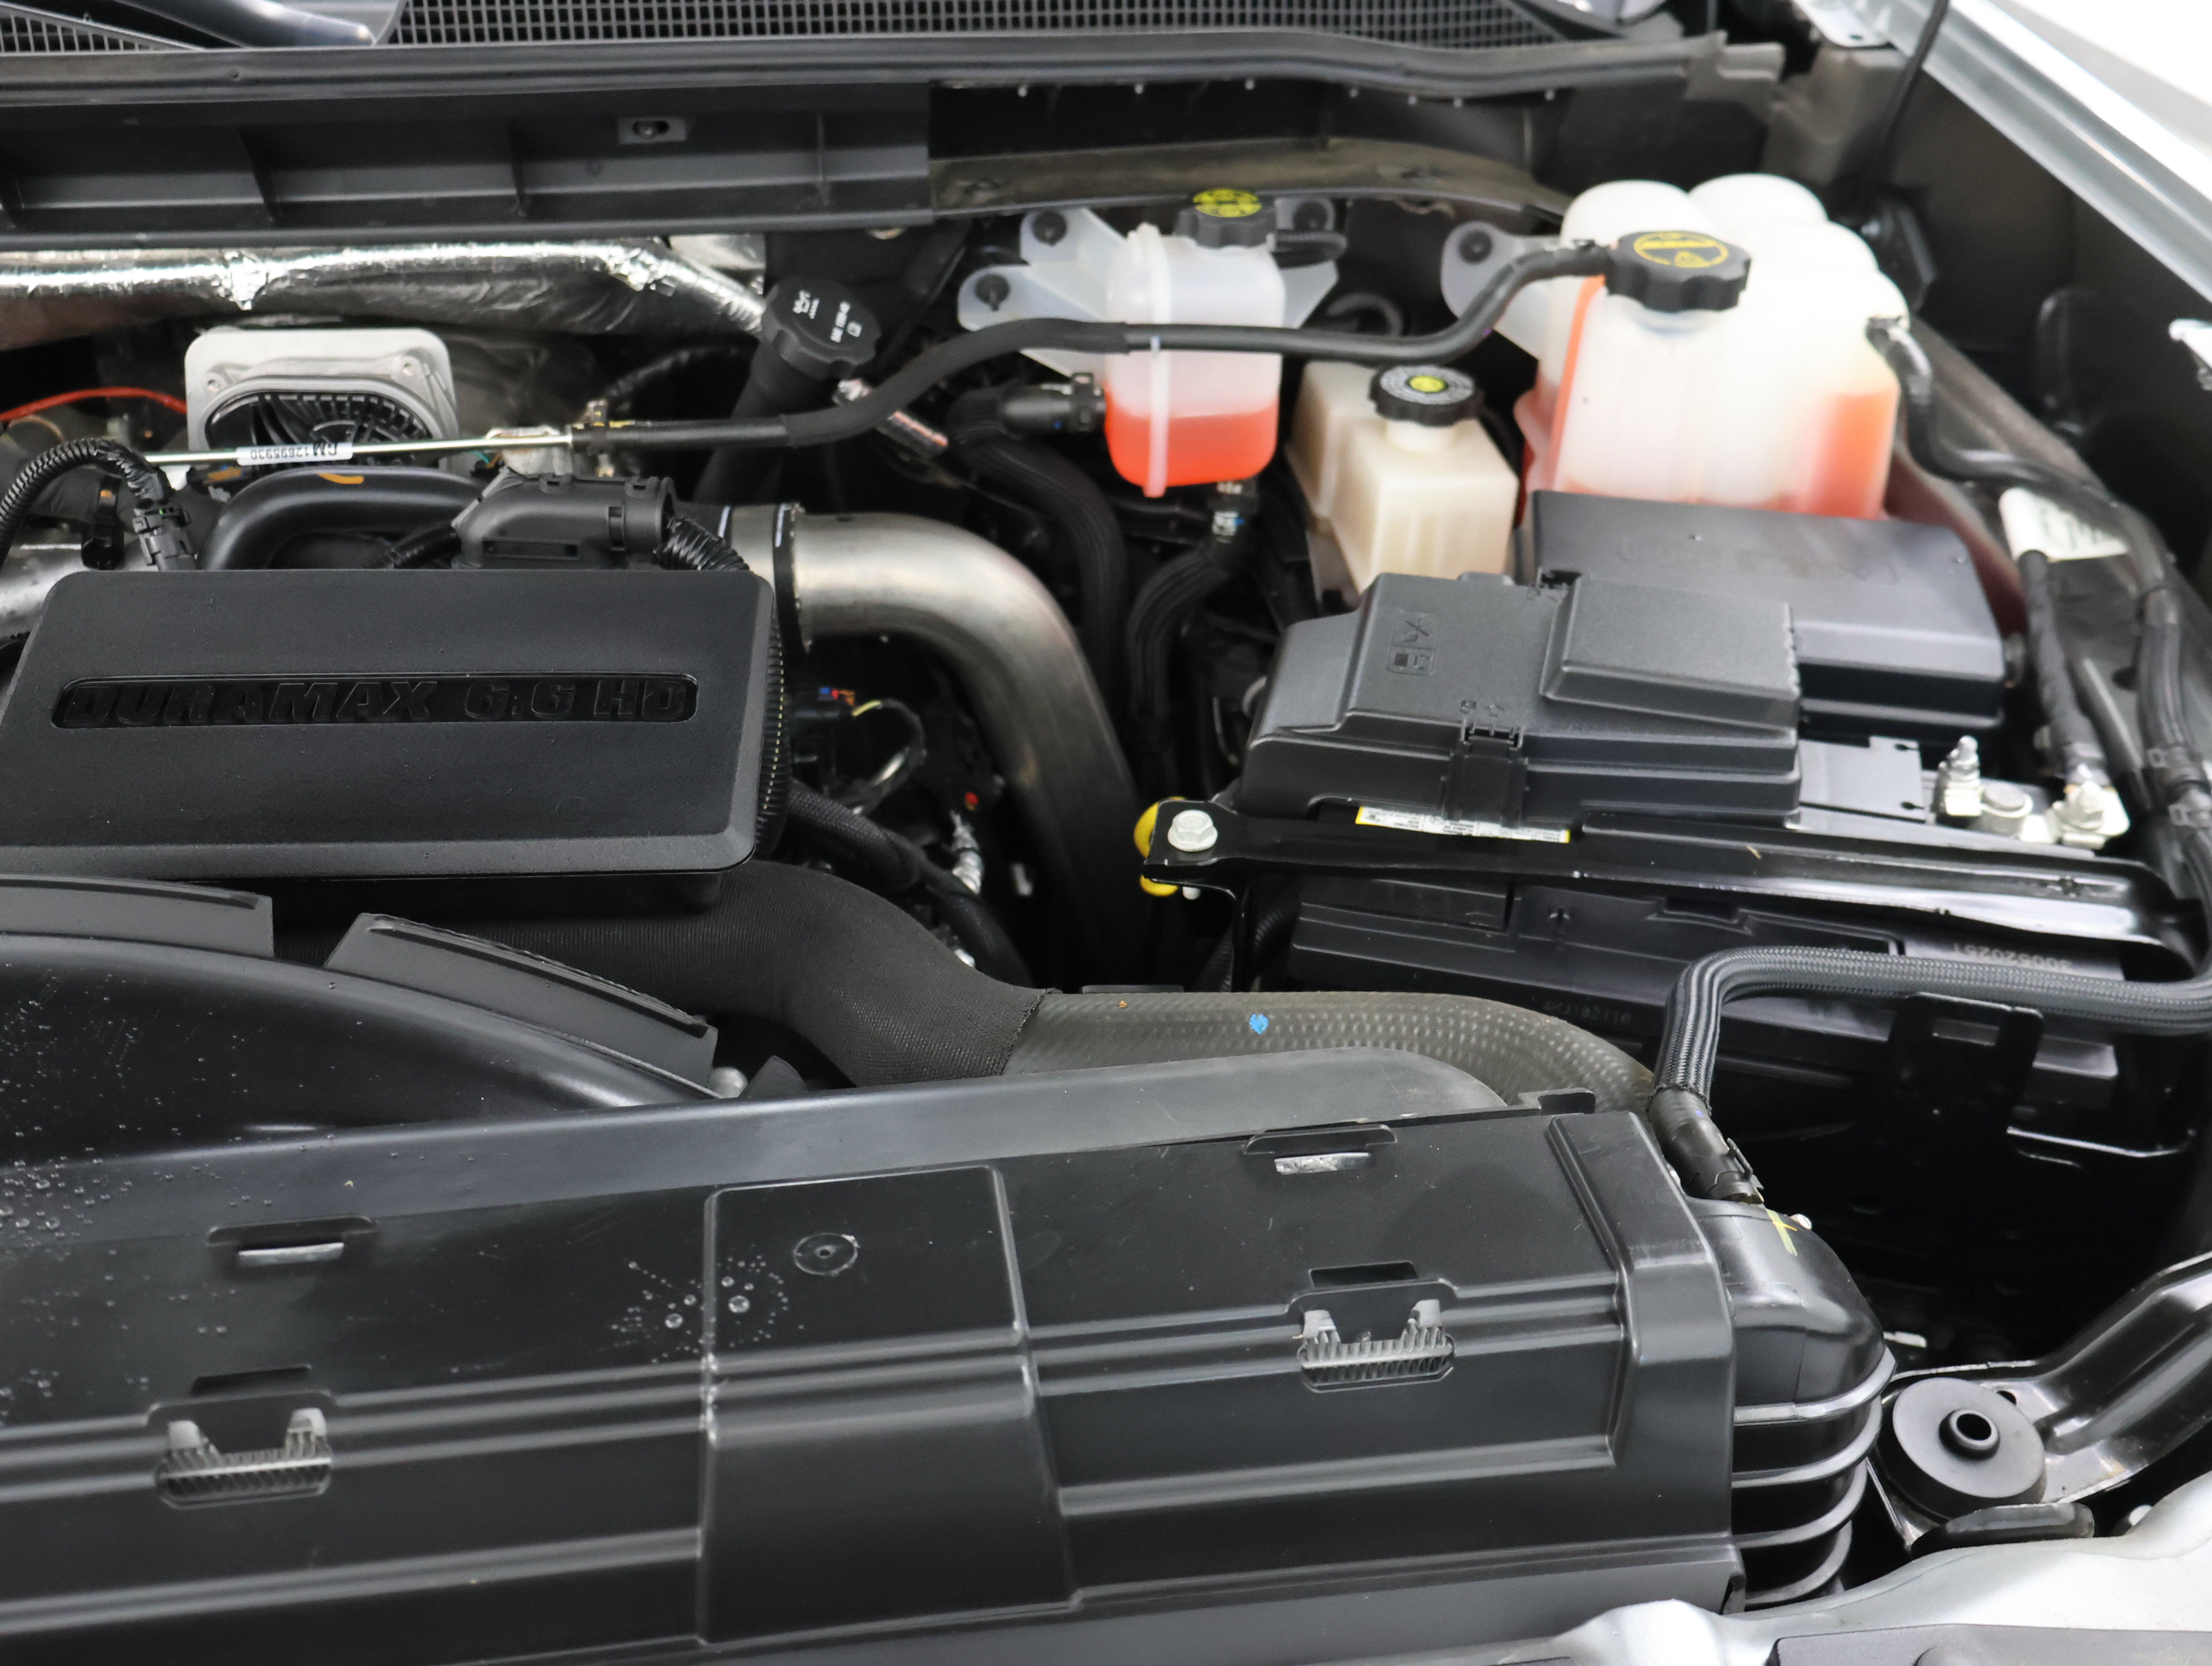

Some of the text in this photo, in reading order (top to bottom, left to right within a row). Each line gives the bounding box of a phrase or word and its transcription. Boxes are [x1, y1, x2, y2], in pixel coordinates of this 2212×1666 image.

[63, 680, 686, 723] DURAMAX 6.6 HD
